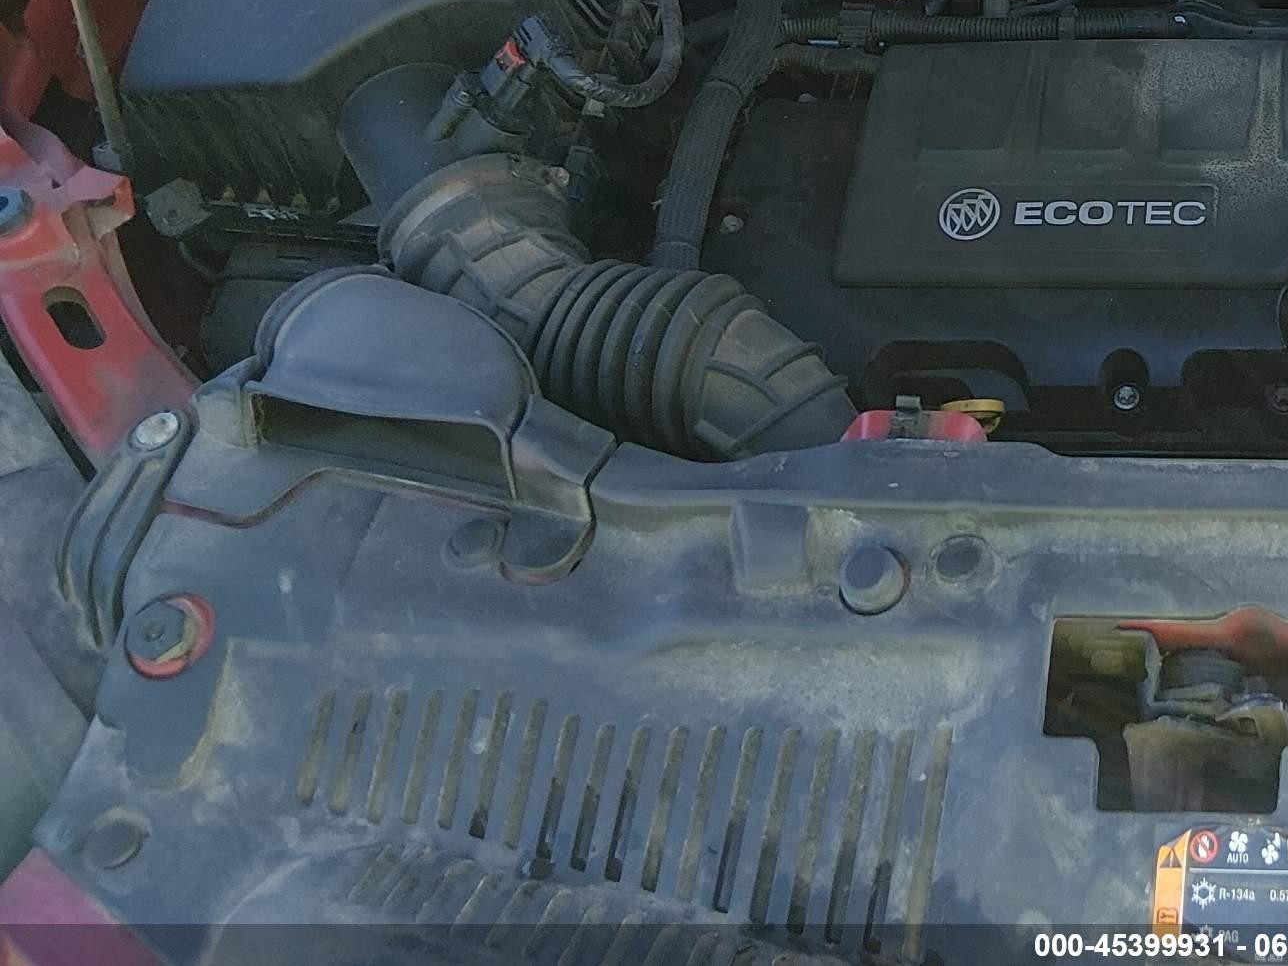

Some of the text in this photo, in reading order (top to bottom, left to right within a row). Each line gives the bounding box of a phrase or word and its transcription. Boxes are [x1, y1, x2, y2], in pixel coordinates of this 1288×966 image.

[1014, 200, 1206, 226] ECOTEC
[1226, 853, 1249, 864] AUTO
[1219, 887, 1255, 901] R-134a
